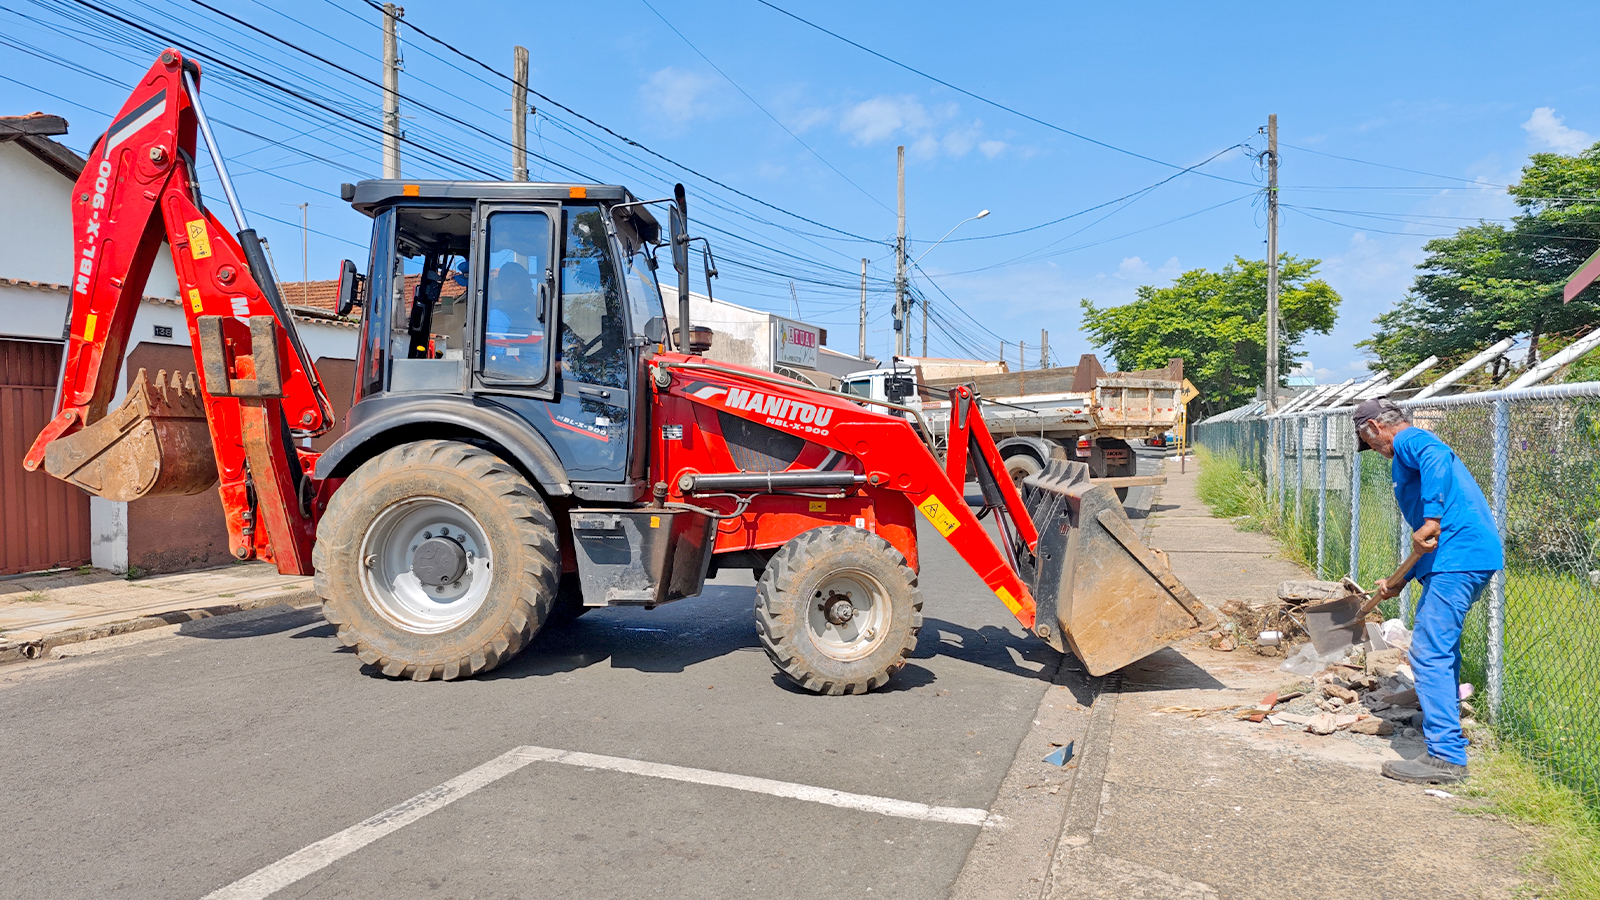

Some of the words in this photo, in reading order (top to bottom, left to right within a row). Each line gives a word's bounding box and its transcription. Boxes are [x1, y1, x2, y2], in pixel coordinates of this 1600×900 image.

[75, 160, 112, 296] MBL-X-900
[155, 327, 173, 337] 138
[788, 326, 816, 349] ATUAL
[725, 387, 834, 427] MANITOU
[556, 414, 607, 436] MBL-X-900
[766, 417, 829, 436] MBL-X-900
